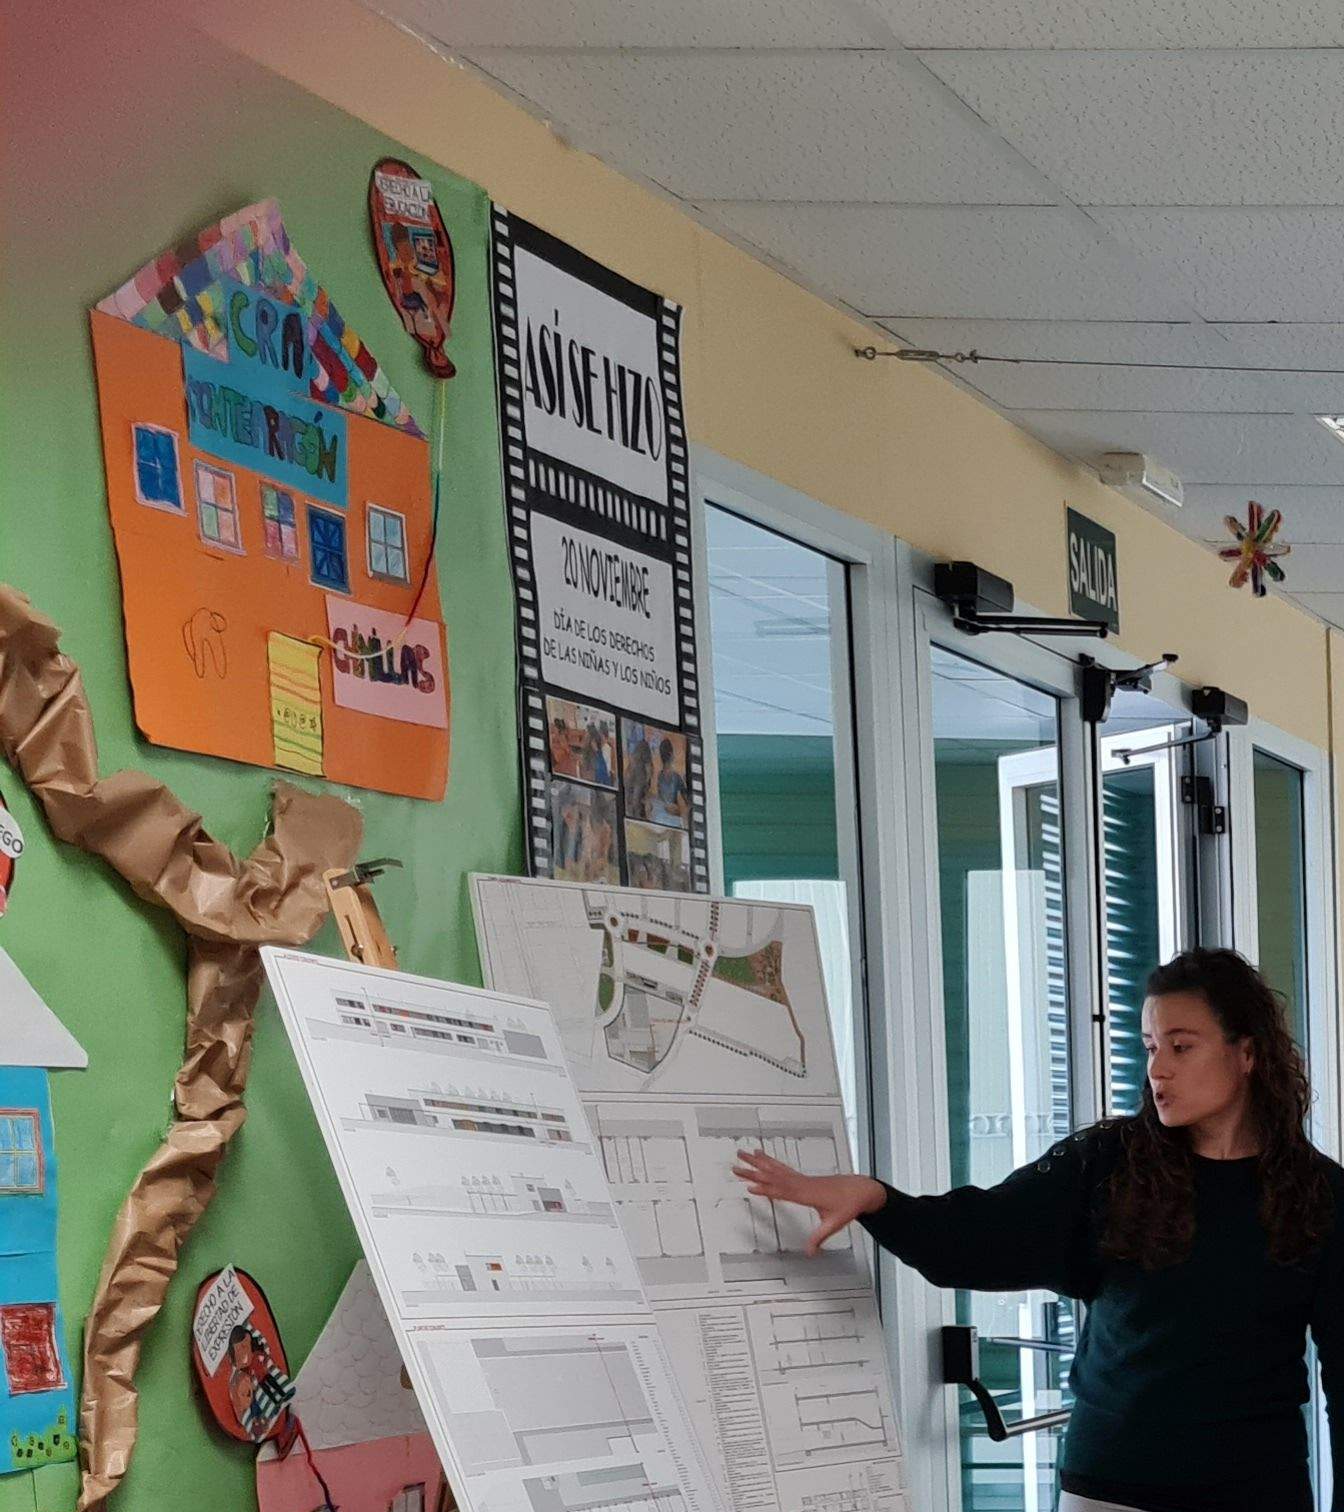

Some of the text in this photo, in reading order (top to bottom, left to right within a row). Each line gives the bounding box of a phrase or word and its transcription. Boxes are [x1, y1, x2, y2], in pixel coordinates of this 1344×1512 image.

[229, 290, 304, 379] CRA
[525, 308, 662, 461] ASÍ SE HIZO
[561, 536, 651, 619] 20 NOVIEMBRE
[1070, 531, 1117, 612] SALIDA
[544, 636, 671, 695] DE LAS NIÑAS Y LOS NIÑOS
[553, 607, 655, 662] DÍA DE LOS DERECHOS
